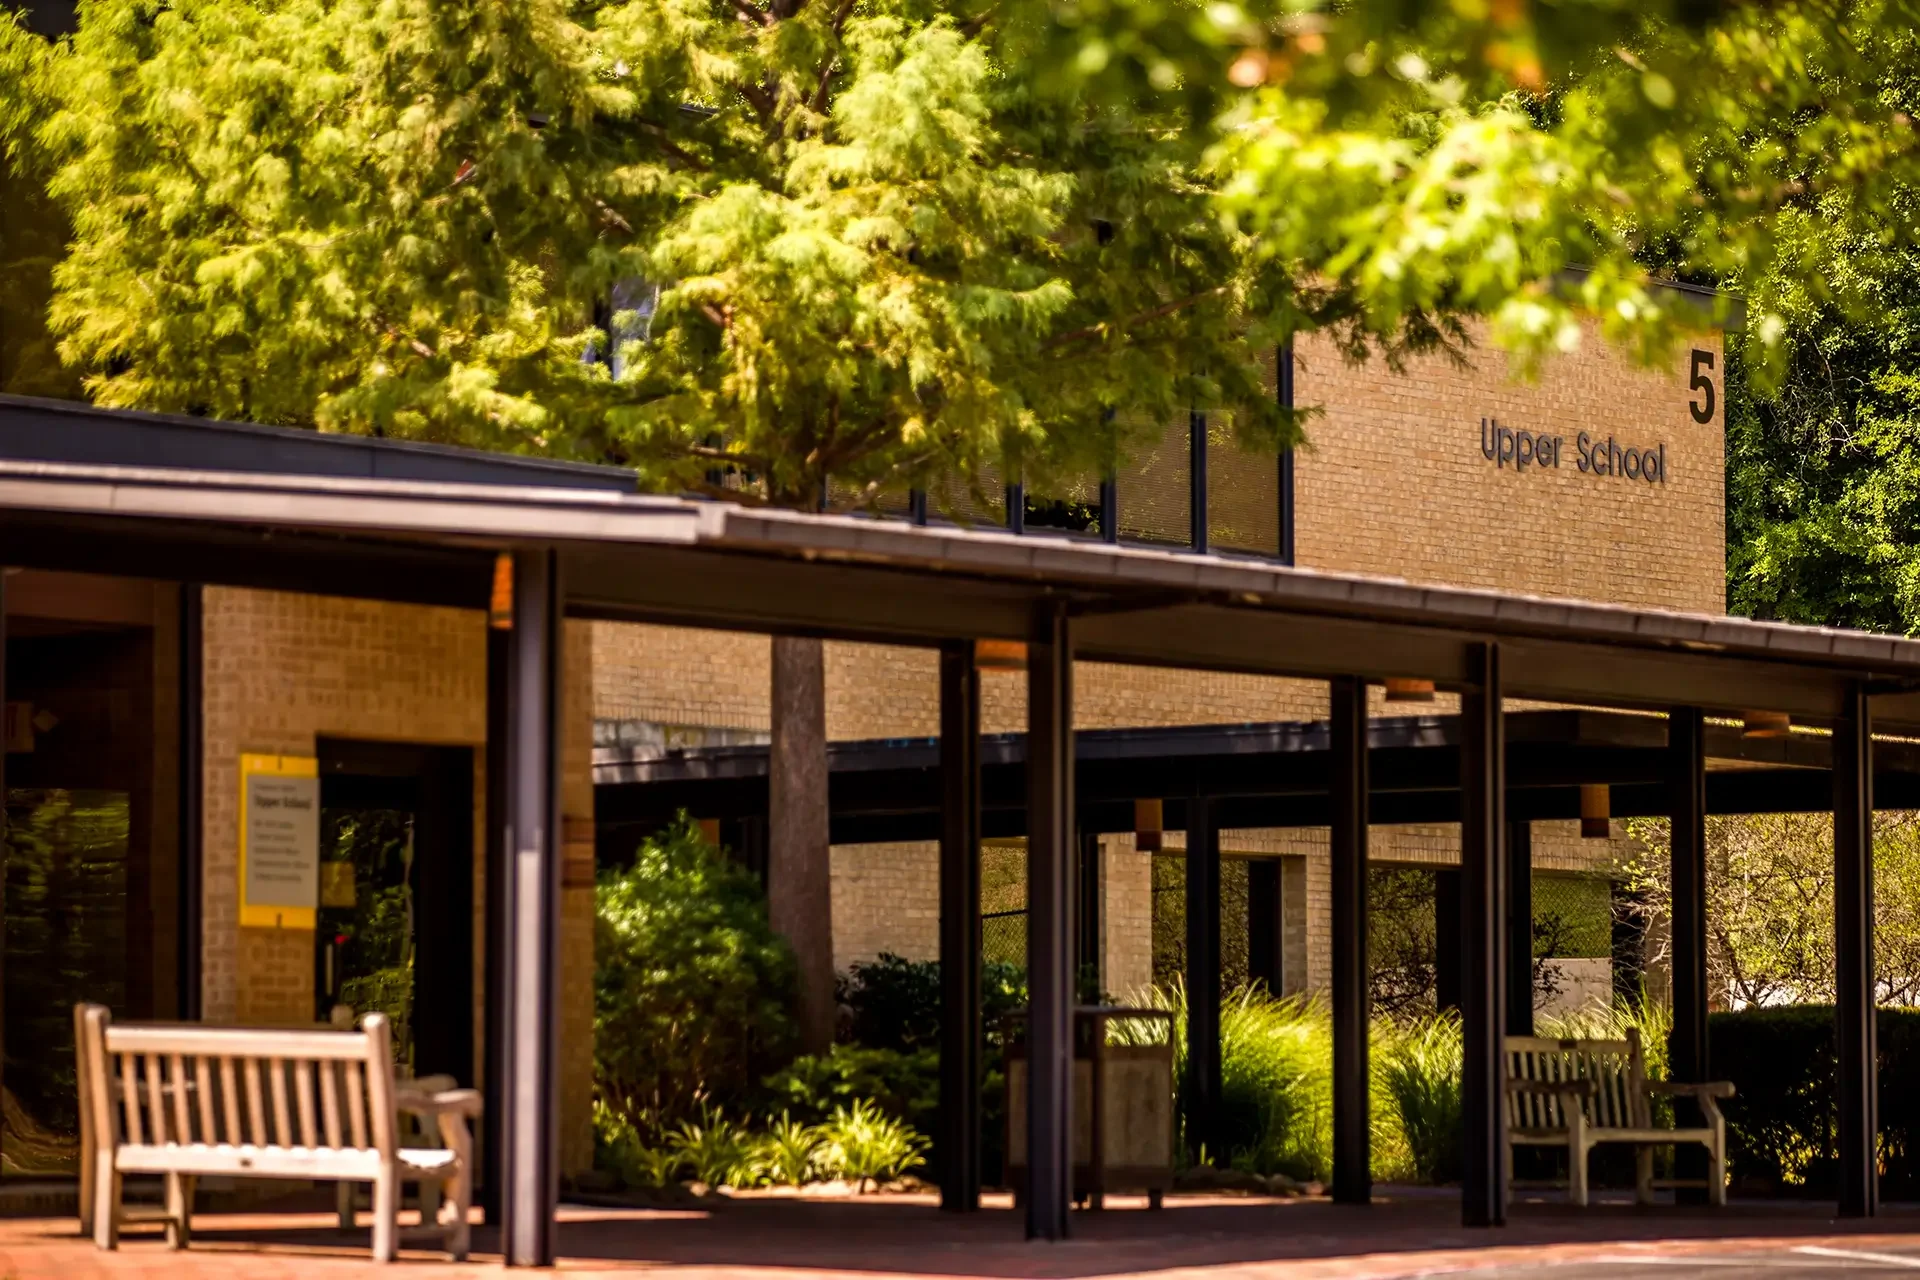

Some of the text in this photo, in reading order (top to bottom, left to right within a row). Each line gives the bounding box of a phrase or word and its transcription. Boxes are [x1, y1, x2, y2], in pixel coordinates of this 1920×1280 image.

[1689, 349, 1715, 424] 5
[1481, 418, 1666, 483] Upper School
